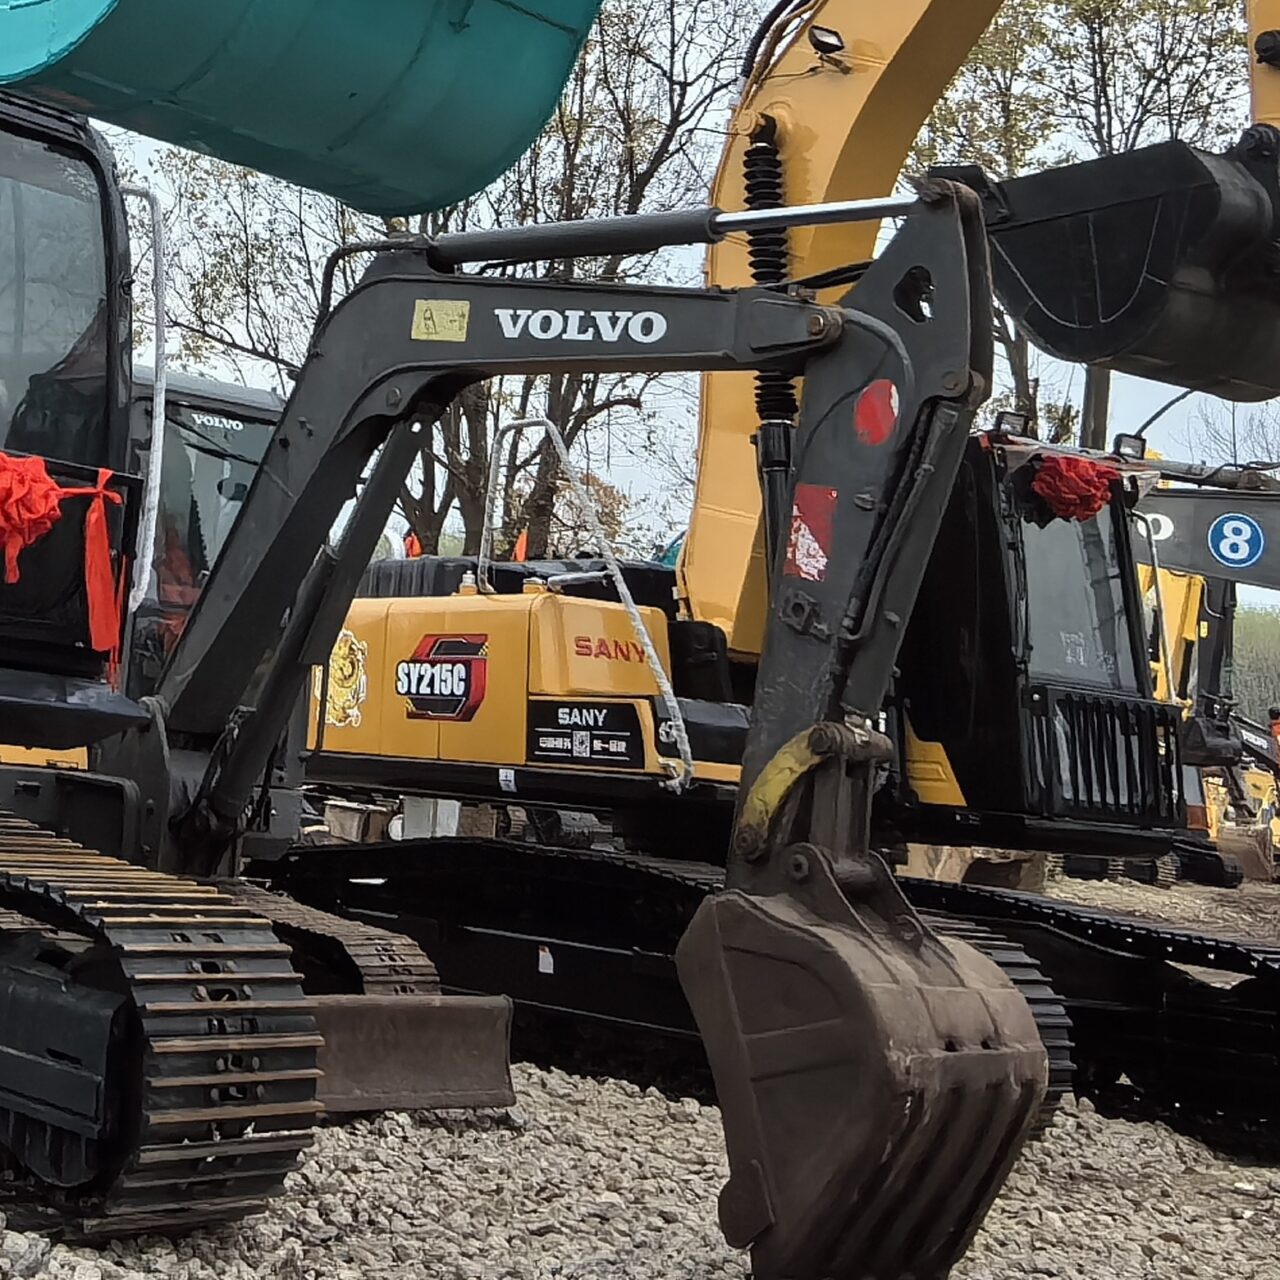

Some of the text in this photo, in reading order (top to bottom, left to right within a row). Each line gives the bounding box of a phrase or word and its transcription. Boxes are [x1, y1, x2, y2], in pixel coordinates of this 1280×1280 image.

[494, 308, 667, 343] VOLVO
[191, 413, 243, 430] VOLVO
[1220, 520, 1253, 560] 8
[575, 636, 647, 663] SANY
[396, 661, 466, 696] SY215C
[558, 708, 607, 726] SANY
